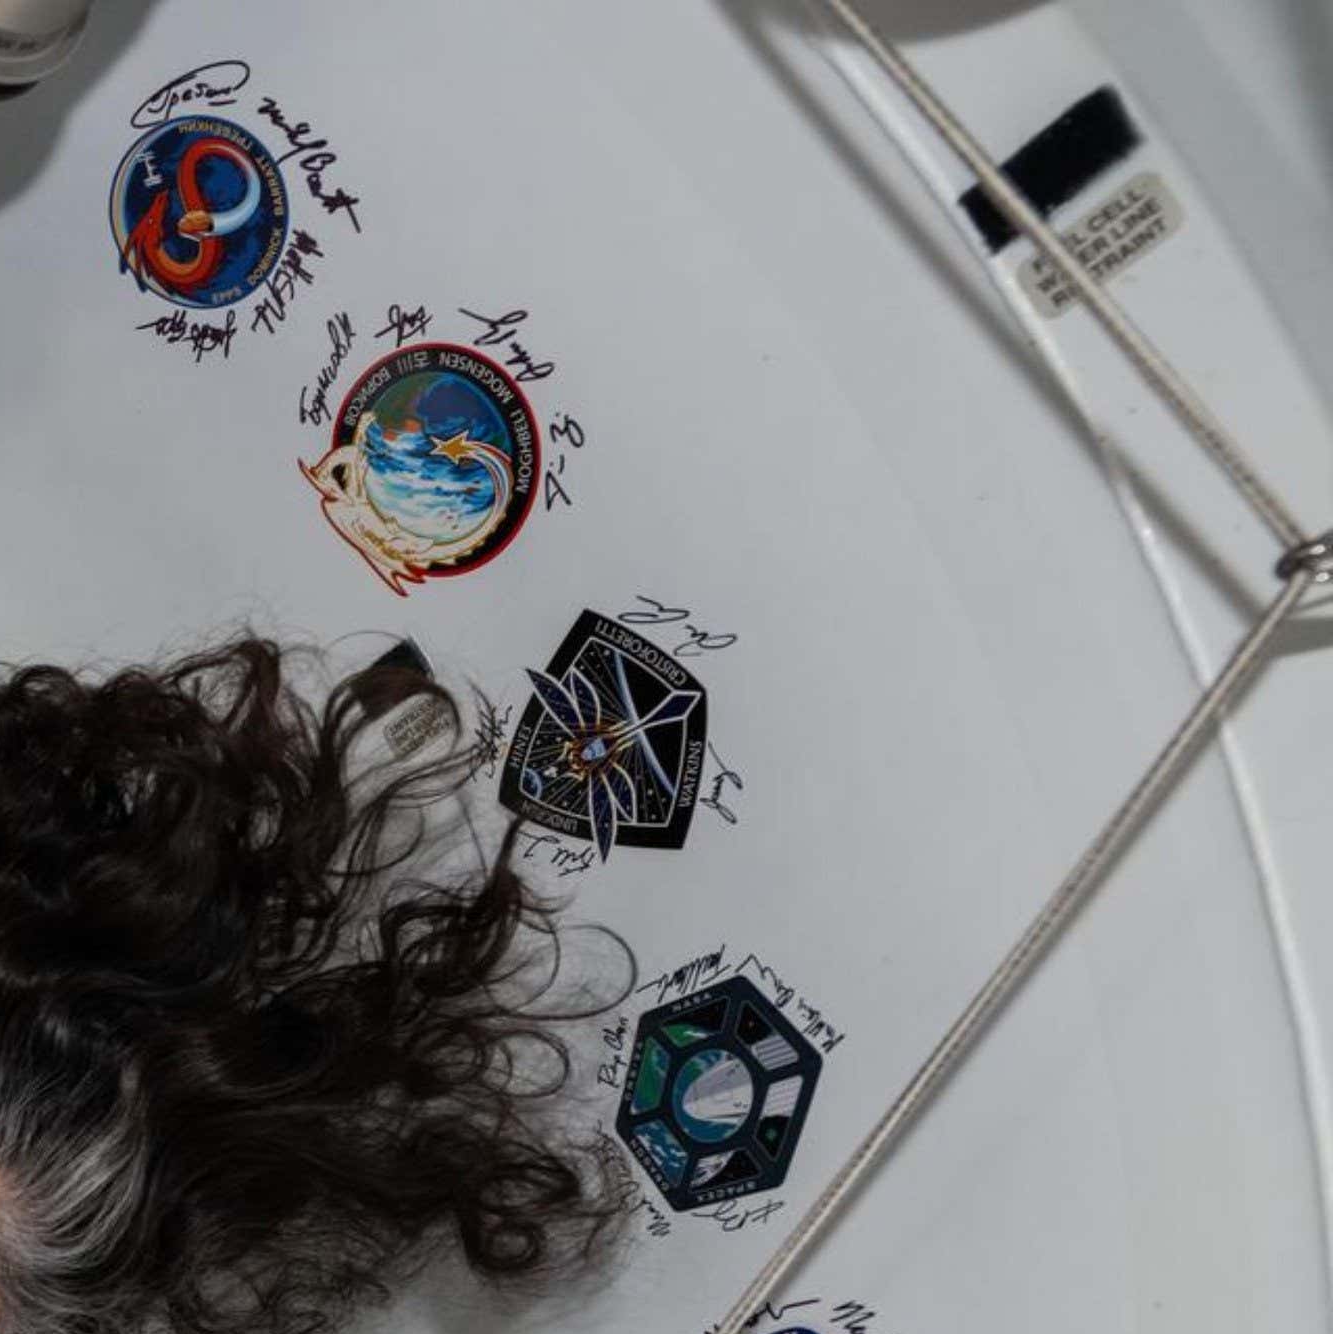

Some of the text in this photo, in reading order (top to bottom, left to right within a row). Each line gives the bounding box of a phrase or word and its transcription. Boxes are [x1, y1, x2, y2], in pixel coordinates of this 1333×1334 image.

[437, 350, 514, 405] MOGENSEN
[508, 408, 535, 495] MOGHBELI
[594, 618, 688, 686] CRISTOFORETTI
[510, 724, 532, 768] HINES
[677, 739, 704, 809] WATKINS
